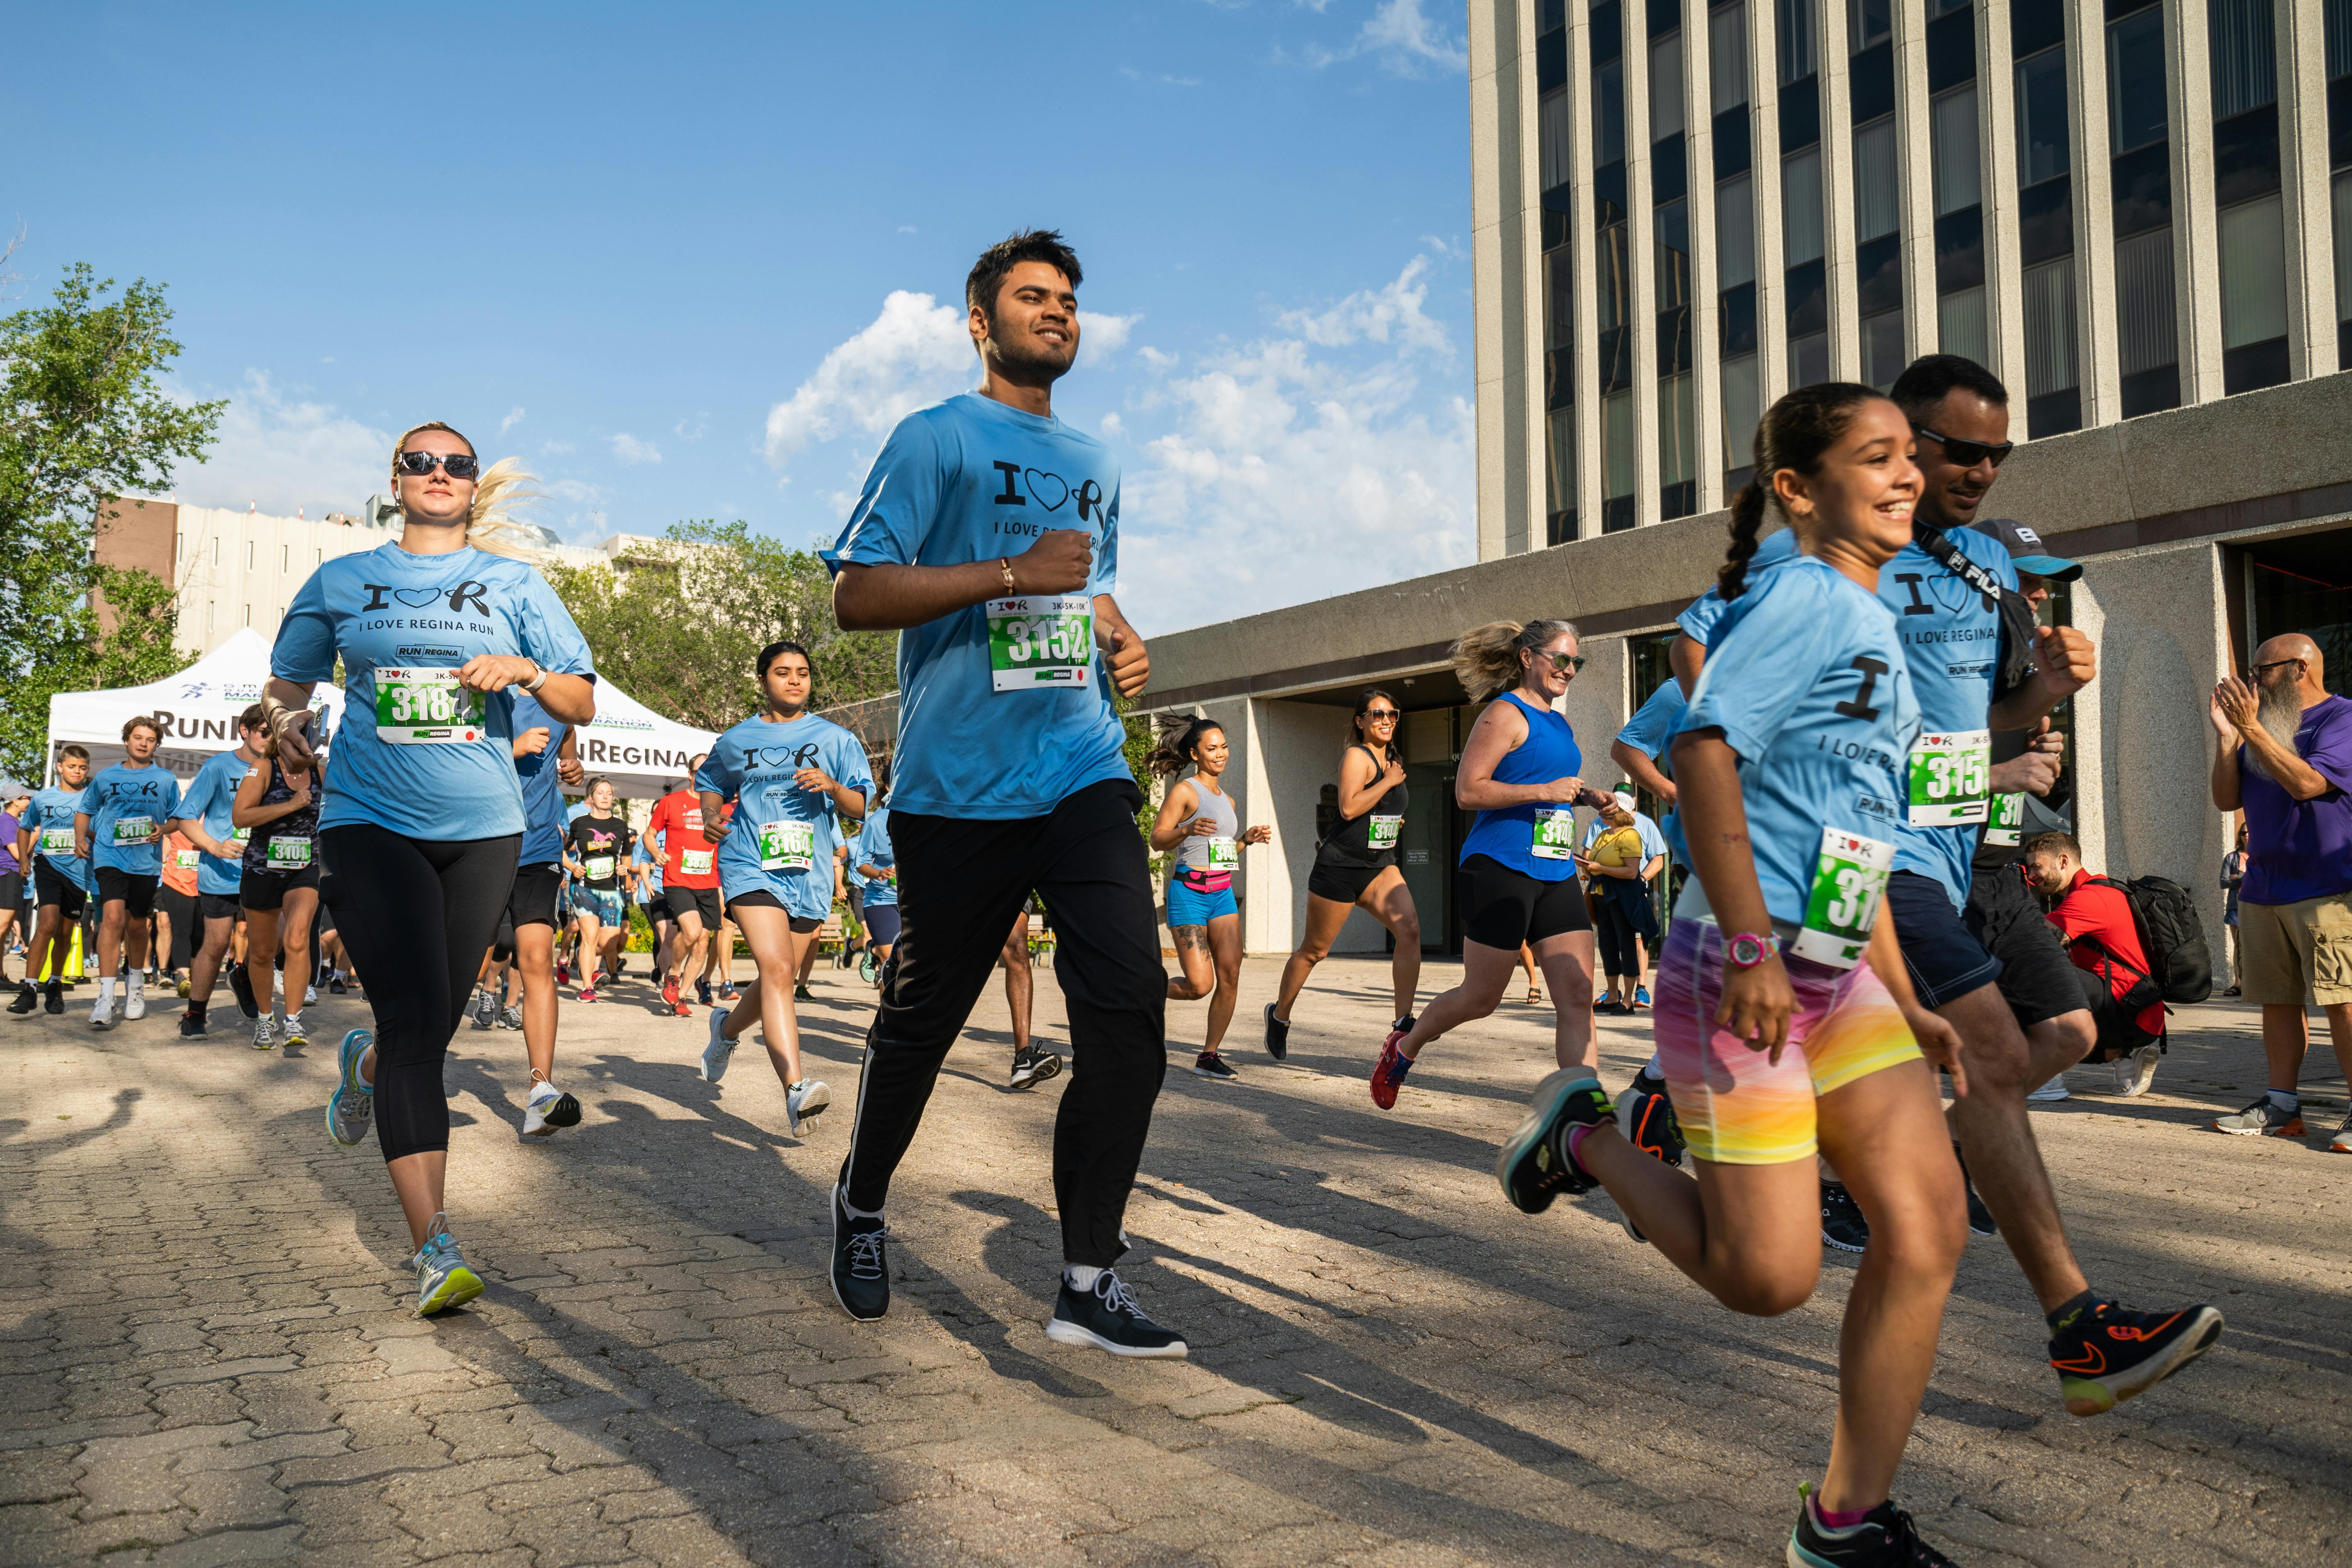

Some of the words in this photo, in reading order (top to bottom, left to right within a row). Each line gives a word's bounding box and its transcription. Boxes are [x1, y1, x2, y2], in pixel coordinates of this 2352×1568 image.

[993, 460, 1026, 506] I
[1071, 479, 1104, 531] R
[995, 522, 998, 533] I
[1004, 522, 1038, 537] LOVE
[1091, 537, 1100, 551] RU
[1965, 565, 2001, 600] FILA
[362, 584, 392, 613] I
[444, 581, 490, 618] R
[1894, 573, 1935, 616] I
[998, 602, 1005, 611] I
[1016, 600, 1028, 610] R
[359, 623, 362, 632] I
[367, 620, 403, 630] LOVE
[410, 620, 464, 630] REGINA
[470, 623, 493, 636] RUN
[1906, 633, 1909, 644] I
[1915, 631, 1948, 644] LOVE
[1951, 628, 1996, 642] REGINA
[1007, 619, 1084, 661] 3152
[401, 670, 411, 678] R
[1949, 666, 1967, 675] RUN
[1833, 656, 1889, 723] I
[391, 687, 472, 721] 3184
[594, 719, 652, 727] RATHON
[1818, 735, 1827, 750] I
[1923, 737, 1929, 745] I
[1941, 736, 1953, 745] R
[743, 748, 759, 771] I
[792, 743, 820, 769] R
[110, 782, 120, 796] I
[140, 781, 158, 797] R
[230, 778, 240, 792] I
[45, 806, 54, 818] I
[119, 824, 145, 838] 3177
[1375, 824, 1398, 839] 3144
[1542, 821, 1572, 845] 3148
[48, 835, 75, 848] 3178
[768, 833, 810, 856] 3164
[1838, 836, 1846, 849] I
[1857, 843, 1872, 858] R
[275, 844, 308, 859] 3101
